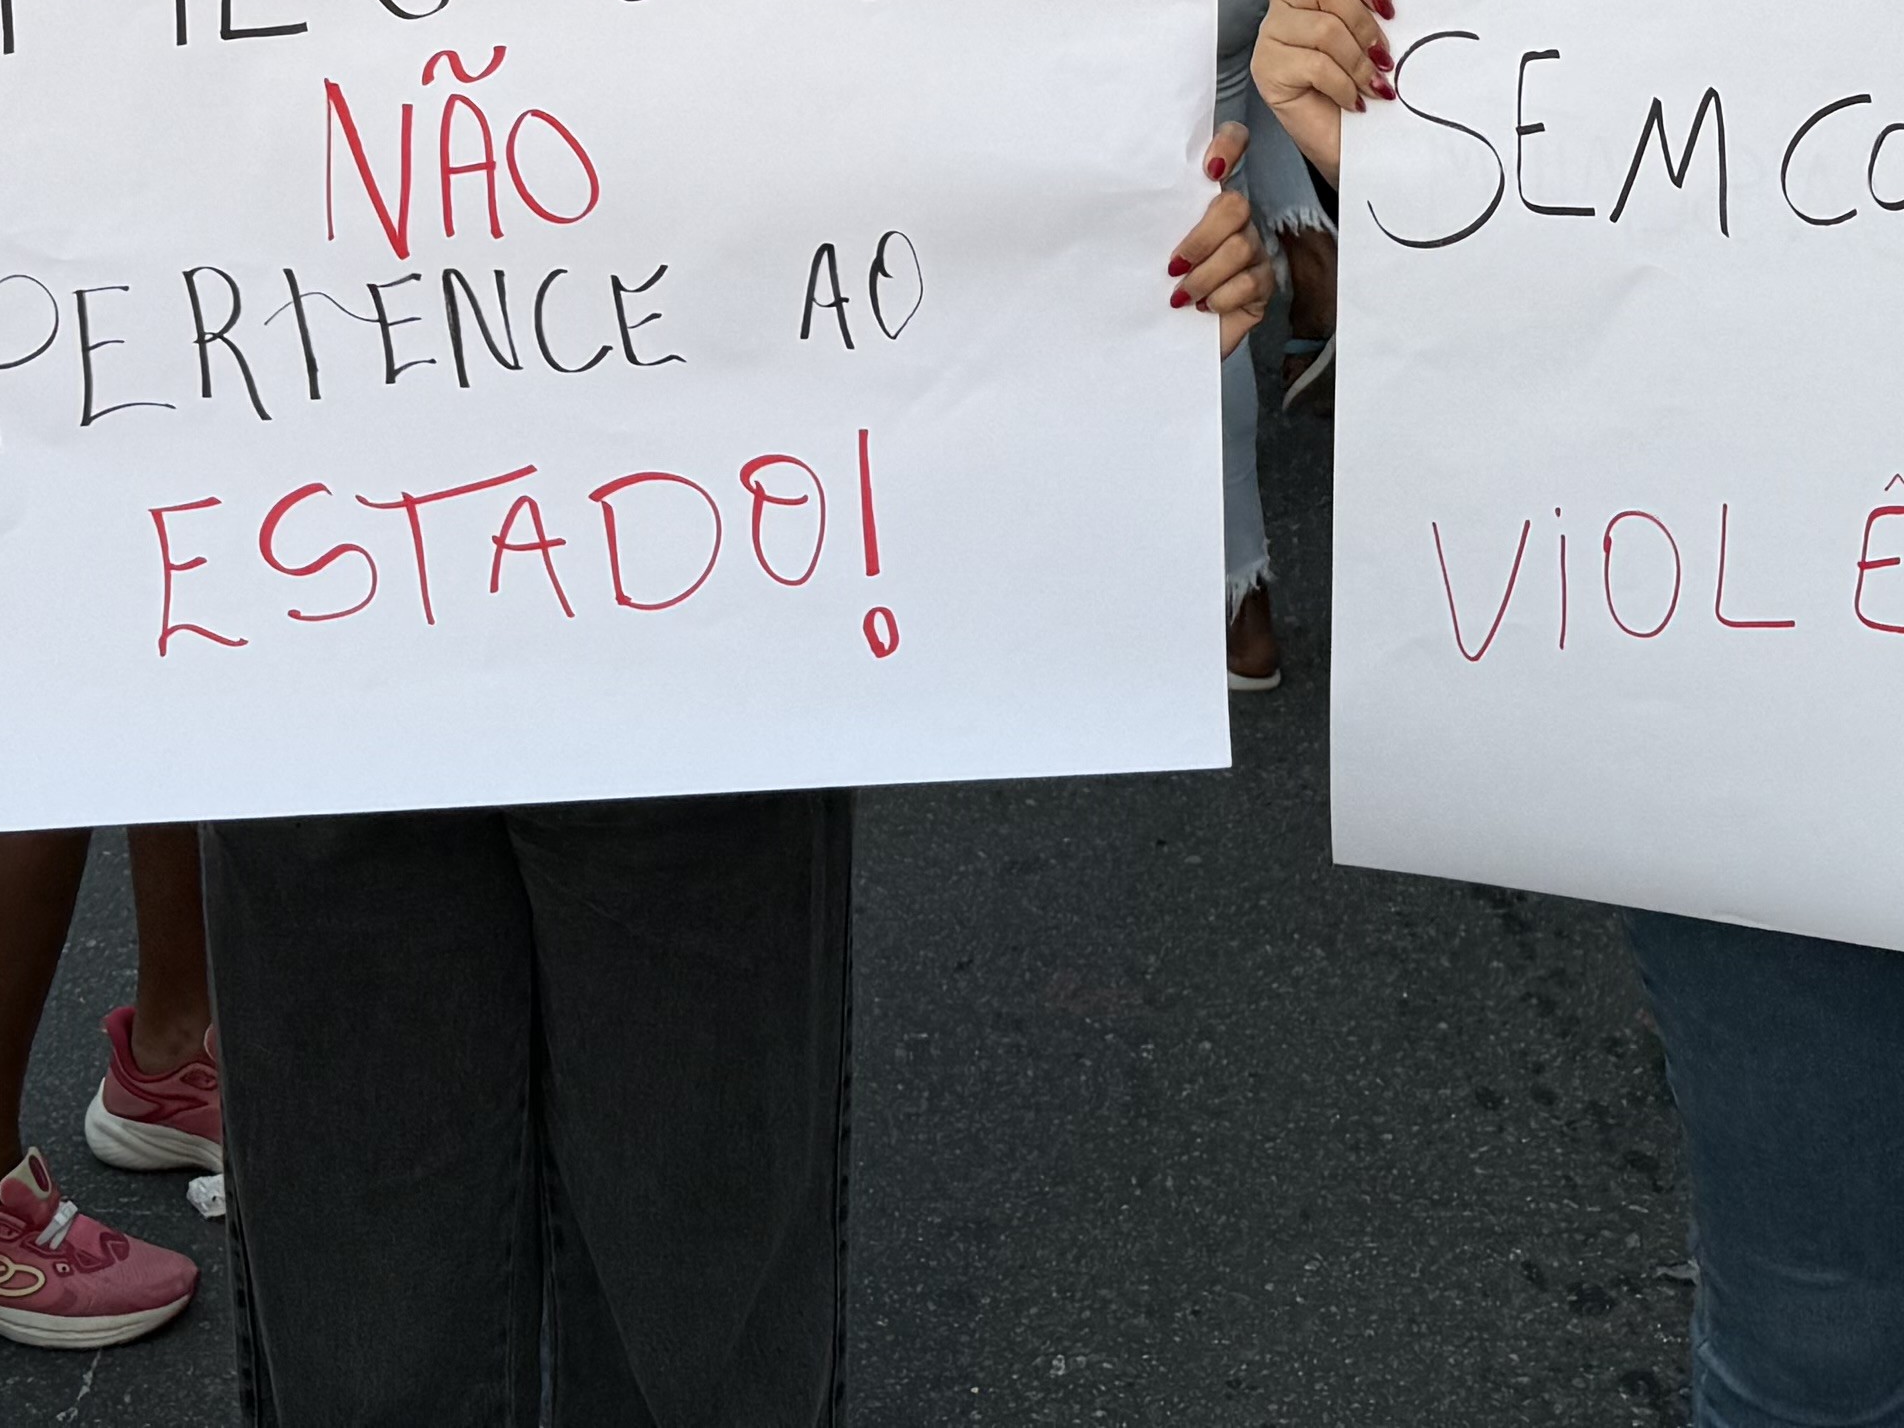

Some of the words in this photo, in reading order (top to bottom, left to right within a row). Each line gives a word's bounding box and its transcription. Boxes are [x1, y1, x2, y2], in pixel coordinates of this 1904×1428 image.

[323, 45, 601, 260] NÃO
[1366, 29, 1731, 250] SEM
[799, 230, 925, 351] AO
[147, 427, 900, 659] ESTADO!
